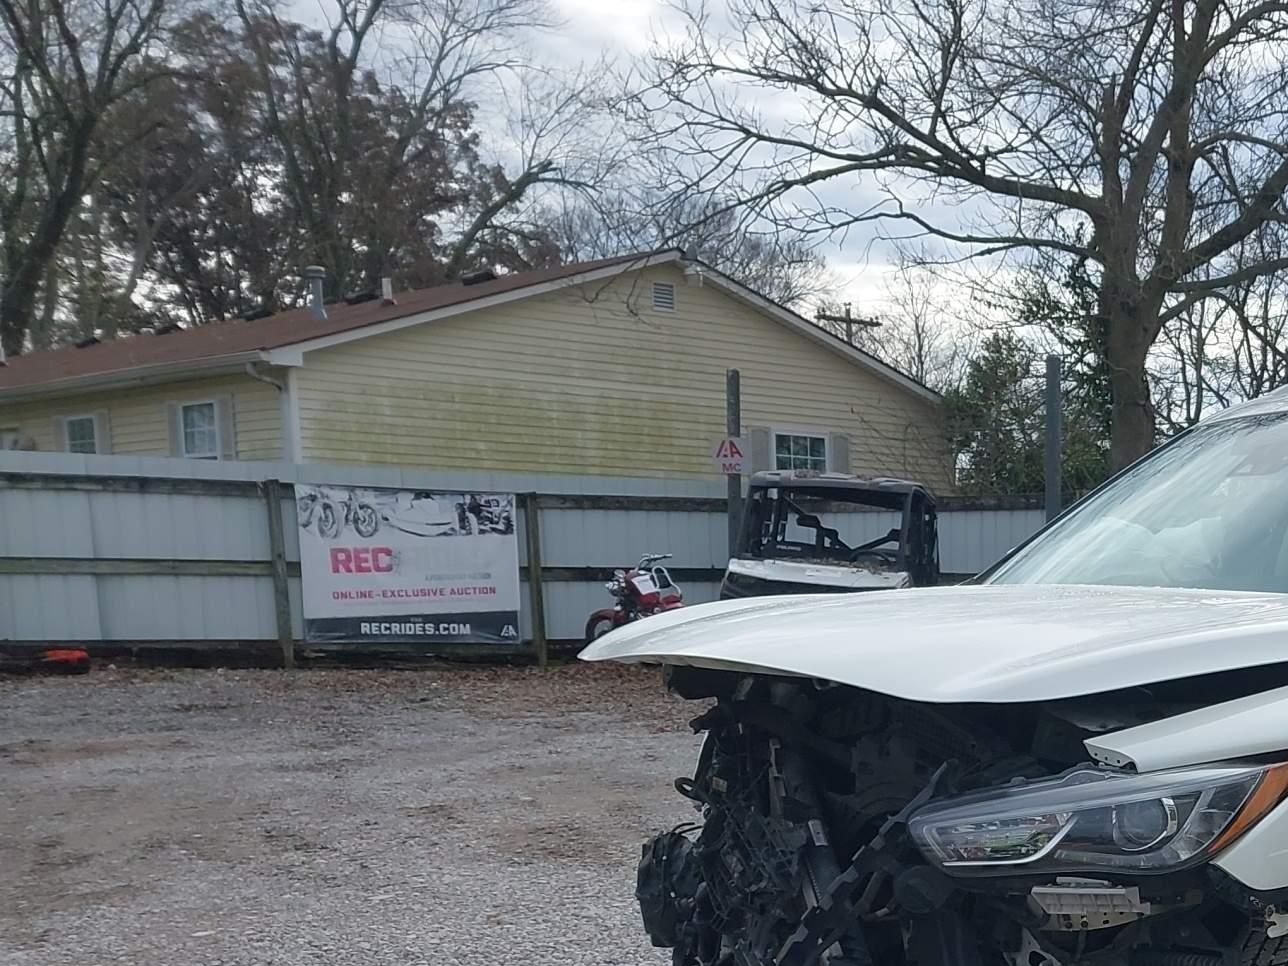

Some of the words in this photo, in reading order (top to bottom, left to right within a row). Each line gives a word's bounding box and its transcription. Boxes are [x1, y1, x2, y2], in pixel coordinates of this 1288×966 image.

[722, 463, 741, 472] MC
[332, 587, 446, 600] ONLINE-EXCLUSIVE
[449, 586, 496, 596] AUCTION
[360, 622, 471, 636] RECRIDES.COM
